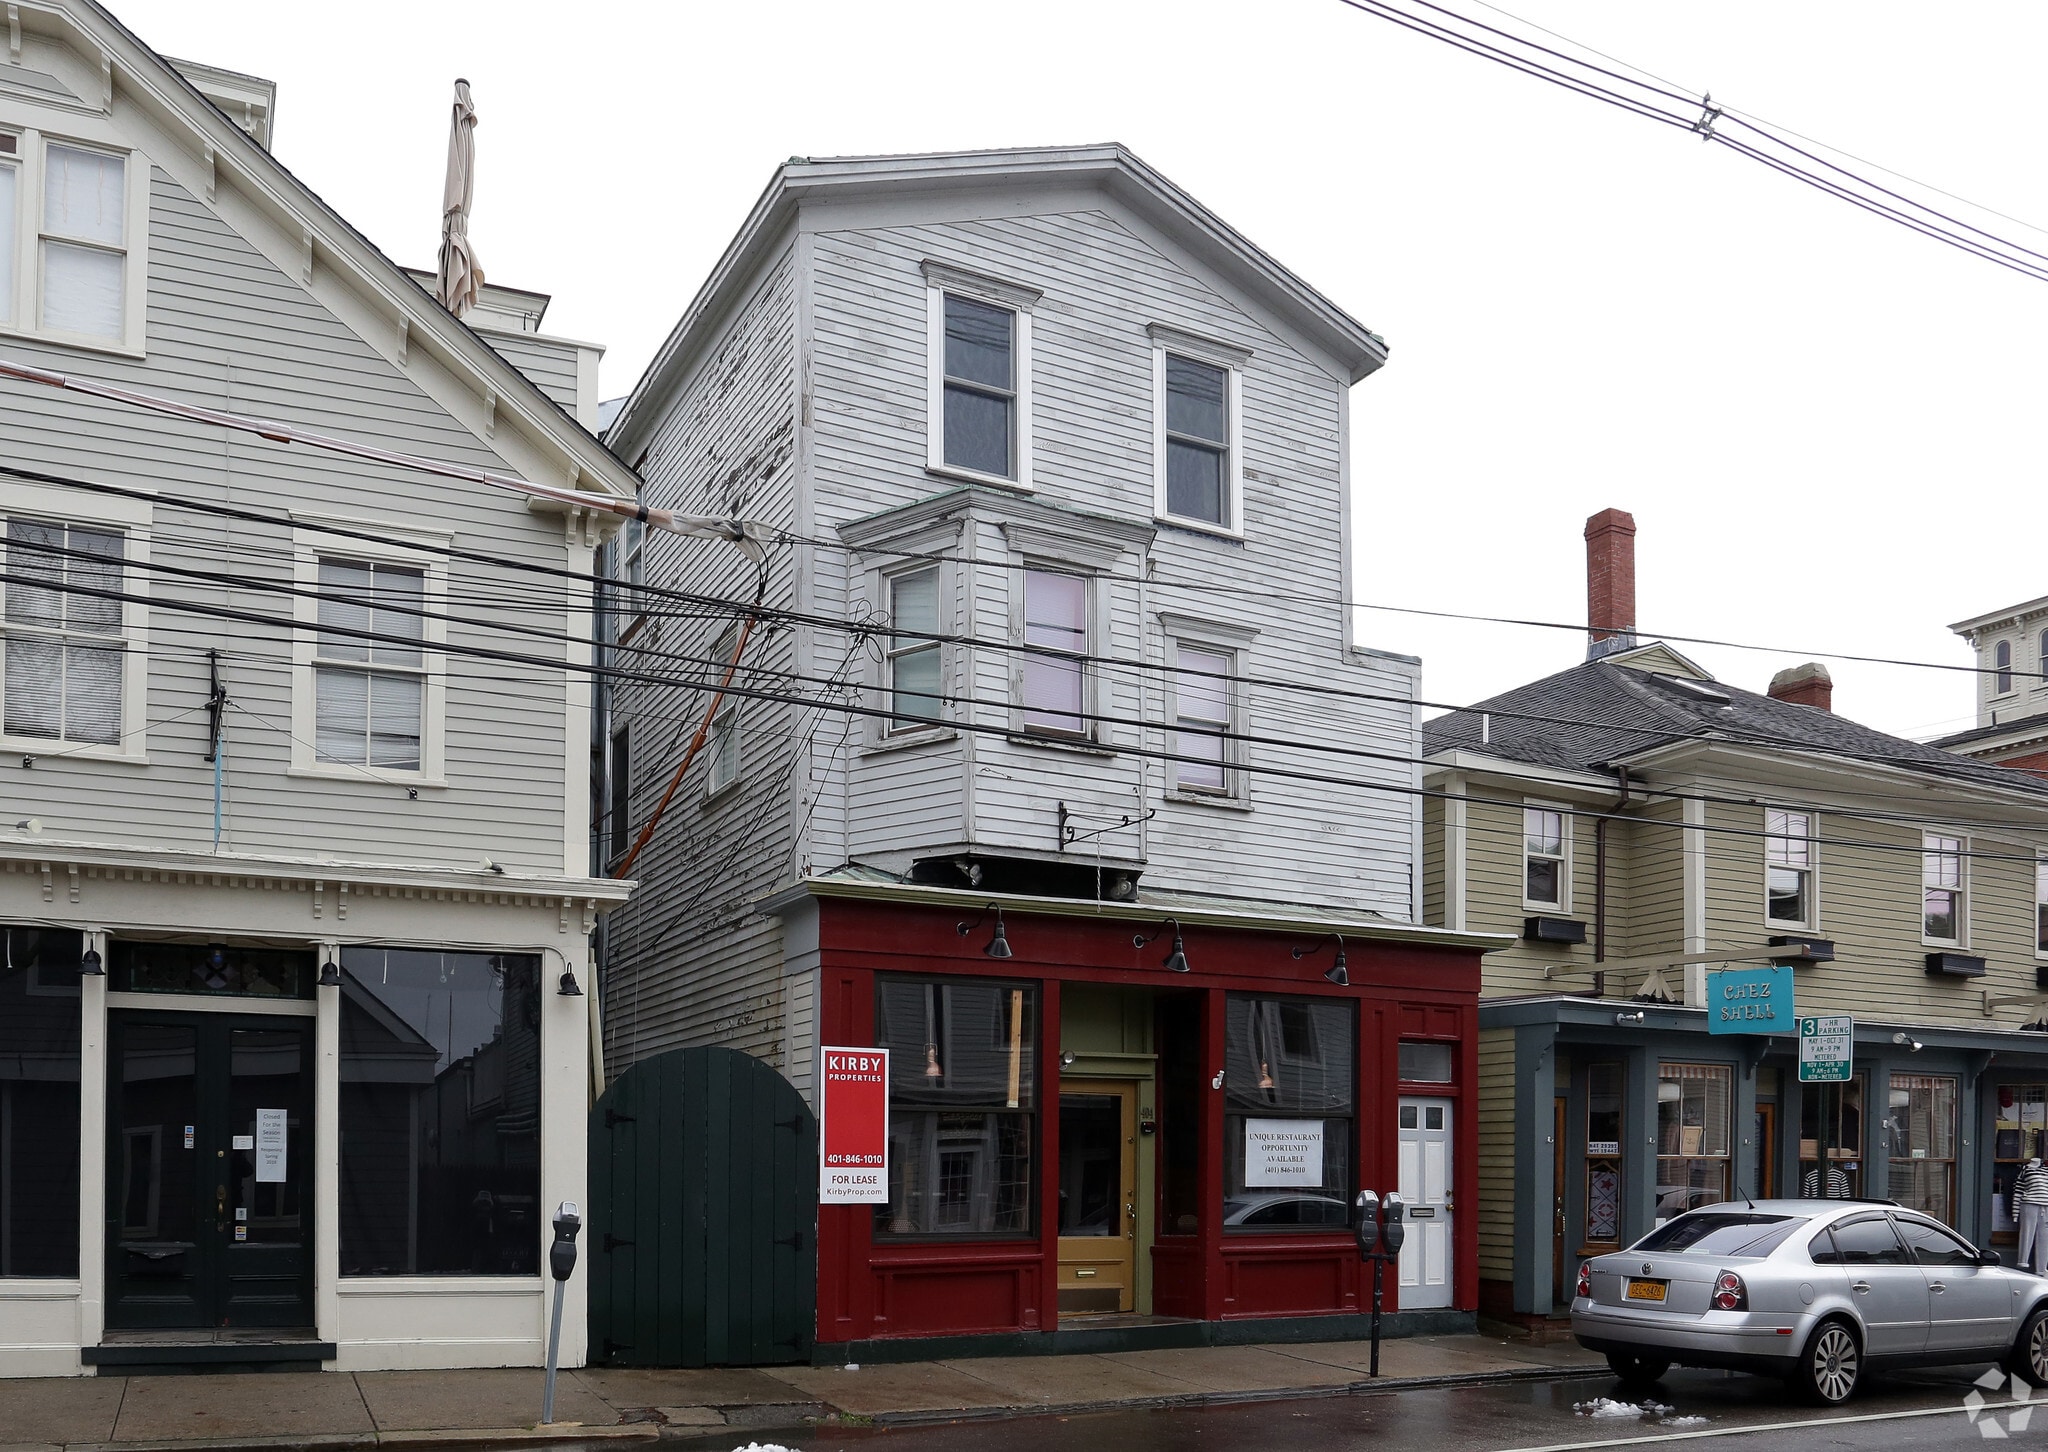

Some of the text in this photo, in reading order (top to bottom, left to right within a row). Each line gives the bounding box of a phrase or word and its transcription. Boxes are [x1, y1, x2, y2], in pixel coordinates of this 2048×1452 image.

[1724, 982, 1771, 1000] CHEZ
[1720, 1003, 1776, 1021] SHELL
[1804, 1020, 1815, 1035] 3
[1818, 1026, 1849, 1034] PARKING
[829, 1055, 881, 1072] KIRBY
[828, 1073, 882, 1082] PROPERTIES
[1249, 1133, 1321, 1142] UNIQUE RESTAURANT
[1261, 1144, 1309, 1152] OPPORTUNITY
[827, 1154, 883, 1164] 401-846-1010
[1266, 1155, 1305, 1163] AVAILABLE
[831, 1175, 878, 1184] FOR LEASE
[826, 1188, 883, 1197] KirbyProp.com
